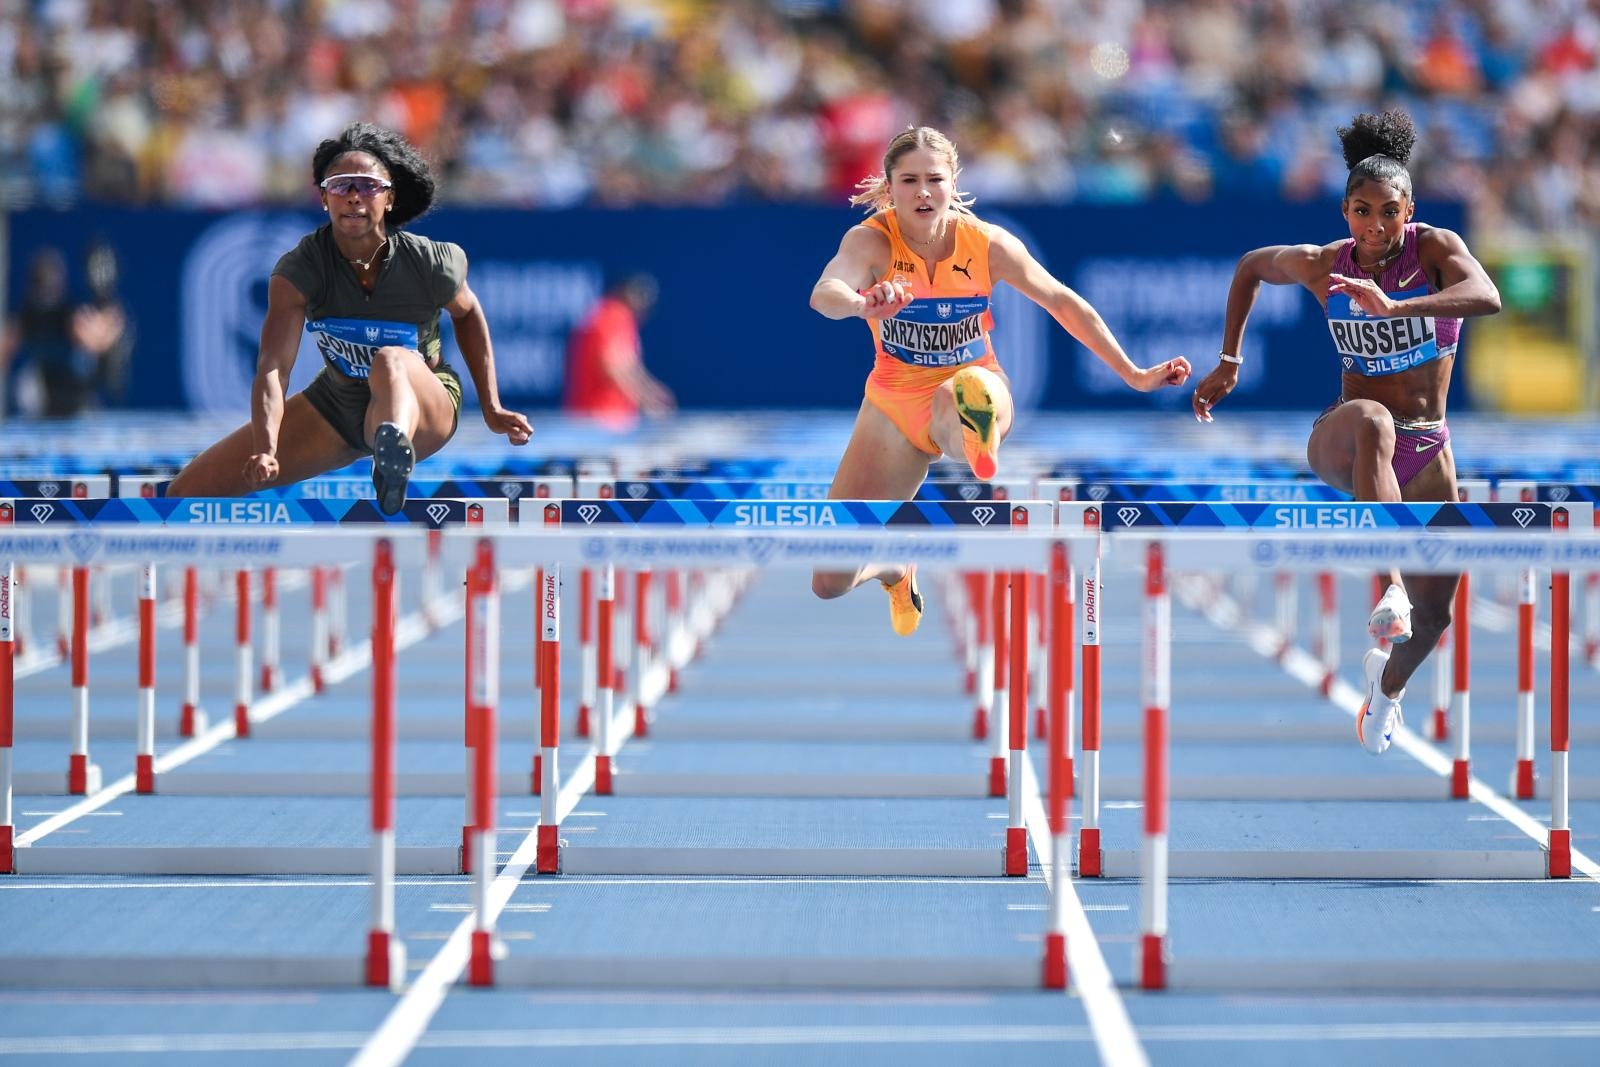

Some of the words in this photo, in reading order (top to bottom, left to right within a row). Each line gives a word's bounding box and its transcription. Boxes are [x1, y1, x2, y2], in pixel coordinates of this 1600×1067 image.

[883, 315, 981, 352] SKRZYSZOWSKA
[1332, 316, 1434, 355] RUSSELL
[913, 347, 973, 365] SILESIA
[1367, 349, 1424, 373] SILESIA
[1221, 487, 1308, 501] SILESIA
[189, 502, 291, 524] SILESIA
[735, 505, 836, 526] SILESIA
[1275, 508, 1377, 530] SILESIA
[545, 575, 556, 620] polanik
[1085, 579, 1097, 623] polanik
